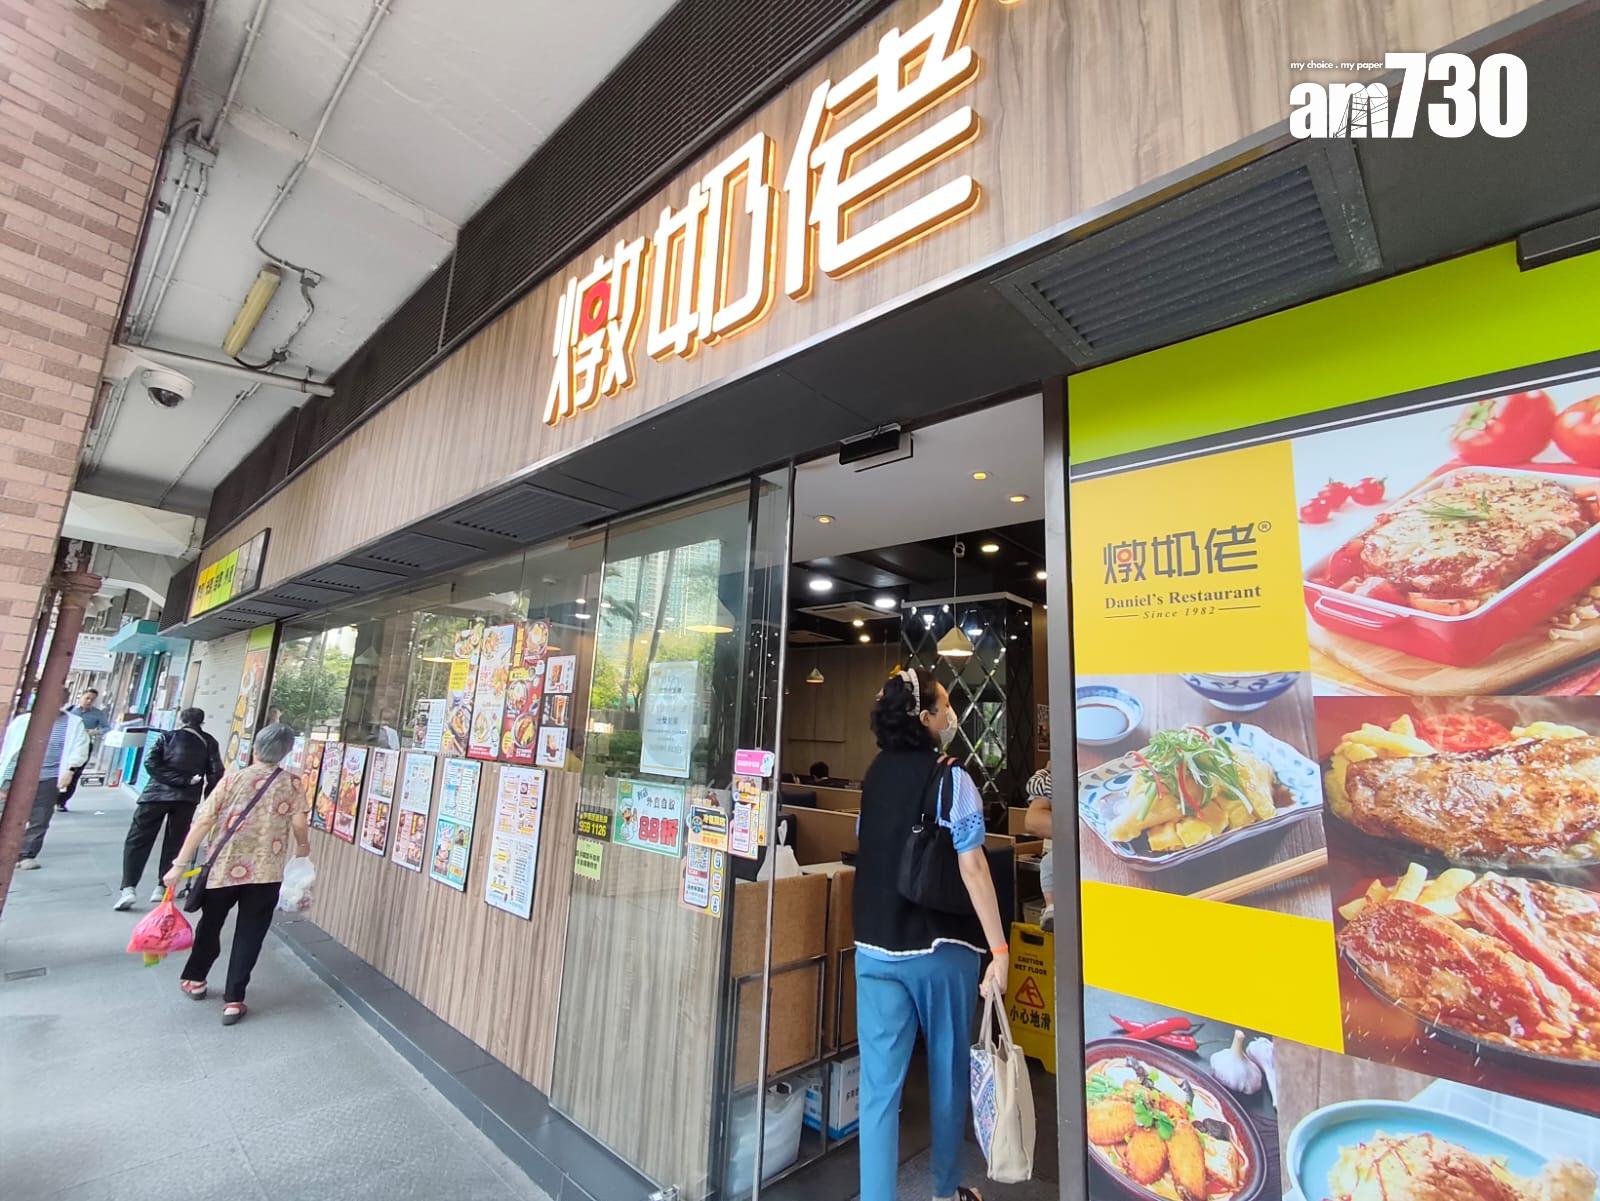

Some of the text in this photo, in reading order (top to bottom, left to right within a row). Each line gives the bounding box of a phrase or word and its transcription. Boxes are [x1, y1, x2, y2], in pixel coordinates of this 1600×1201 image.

[1104, 523, 1258, 584] 燉奶佬
[1105, 585, 1262, 609] Daniel's Restaurant
[1143, 606, 1215, 619] Since 1982
[639, 816, 679, 847] 88折
[1014, 963, 1047, 975] WET FLOOR
[1018, 955, 1044, 966] CAUTION
[1010, 1005, 1051, 1031] 小心地滑
